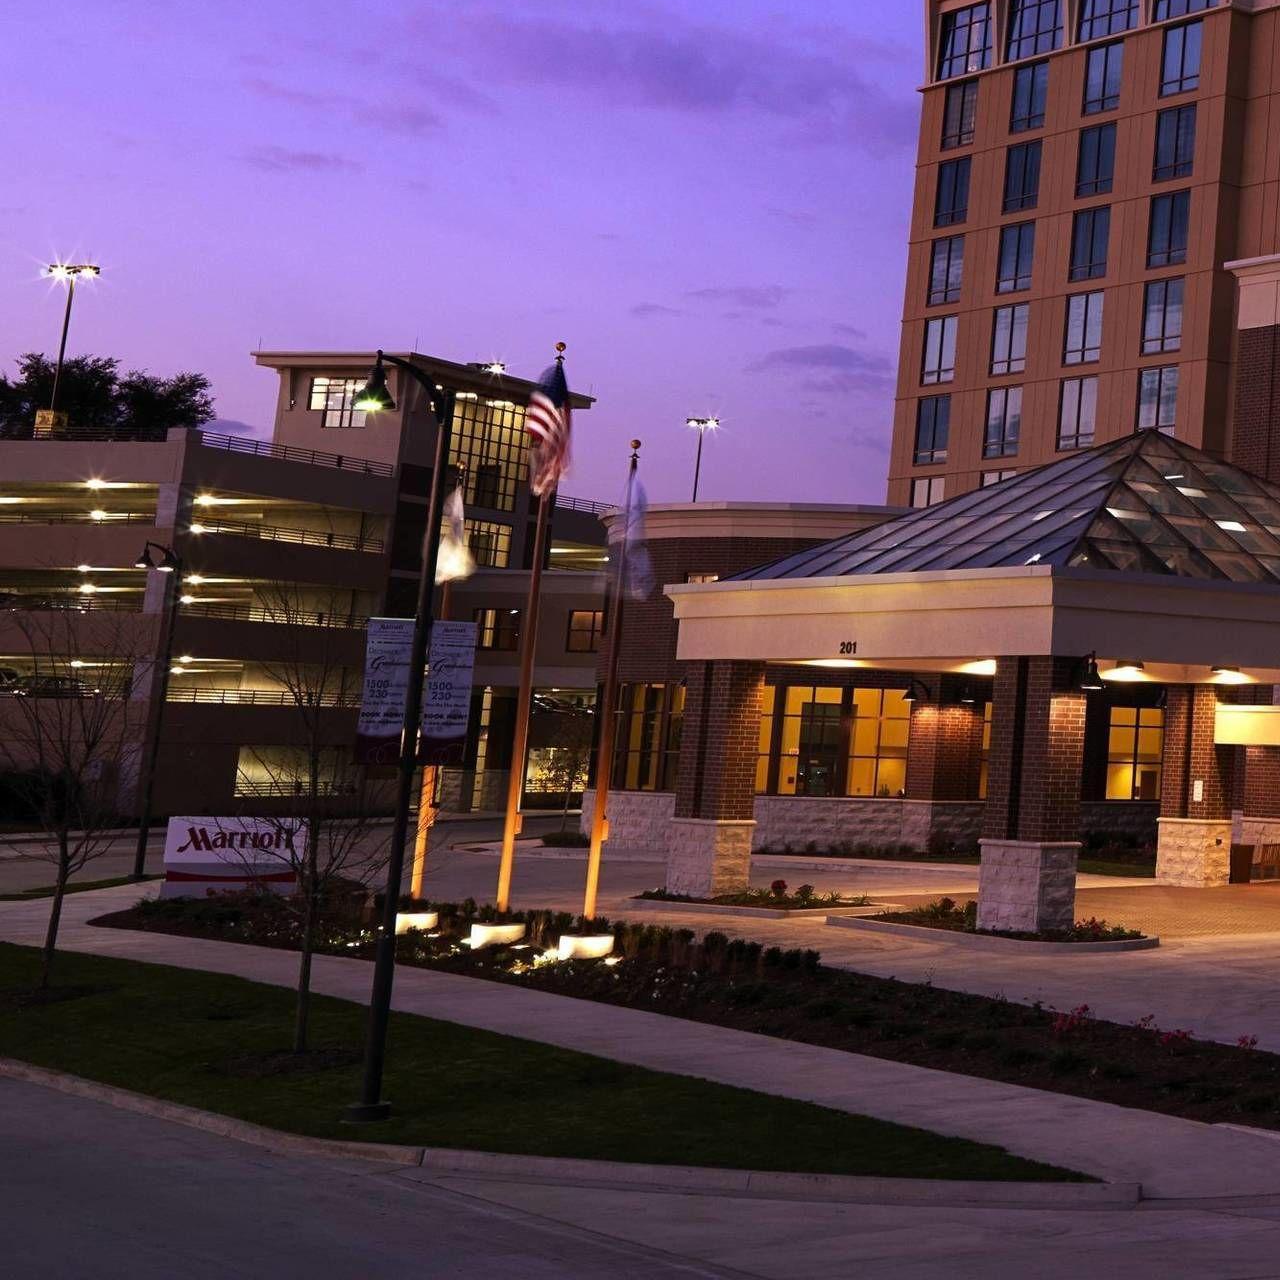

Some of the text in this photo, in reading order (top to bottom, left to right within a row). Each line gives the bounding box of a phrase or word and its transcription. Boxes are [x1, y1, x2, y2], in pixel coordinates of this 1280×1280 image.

[839, 641, 857, 654] 201
[367, 679, 390, 689] 1500
[428, 681, 452, 691] 1500
[369, 689, 388, 698] 230
[432, 691, 452, 700] 230
